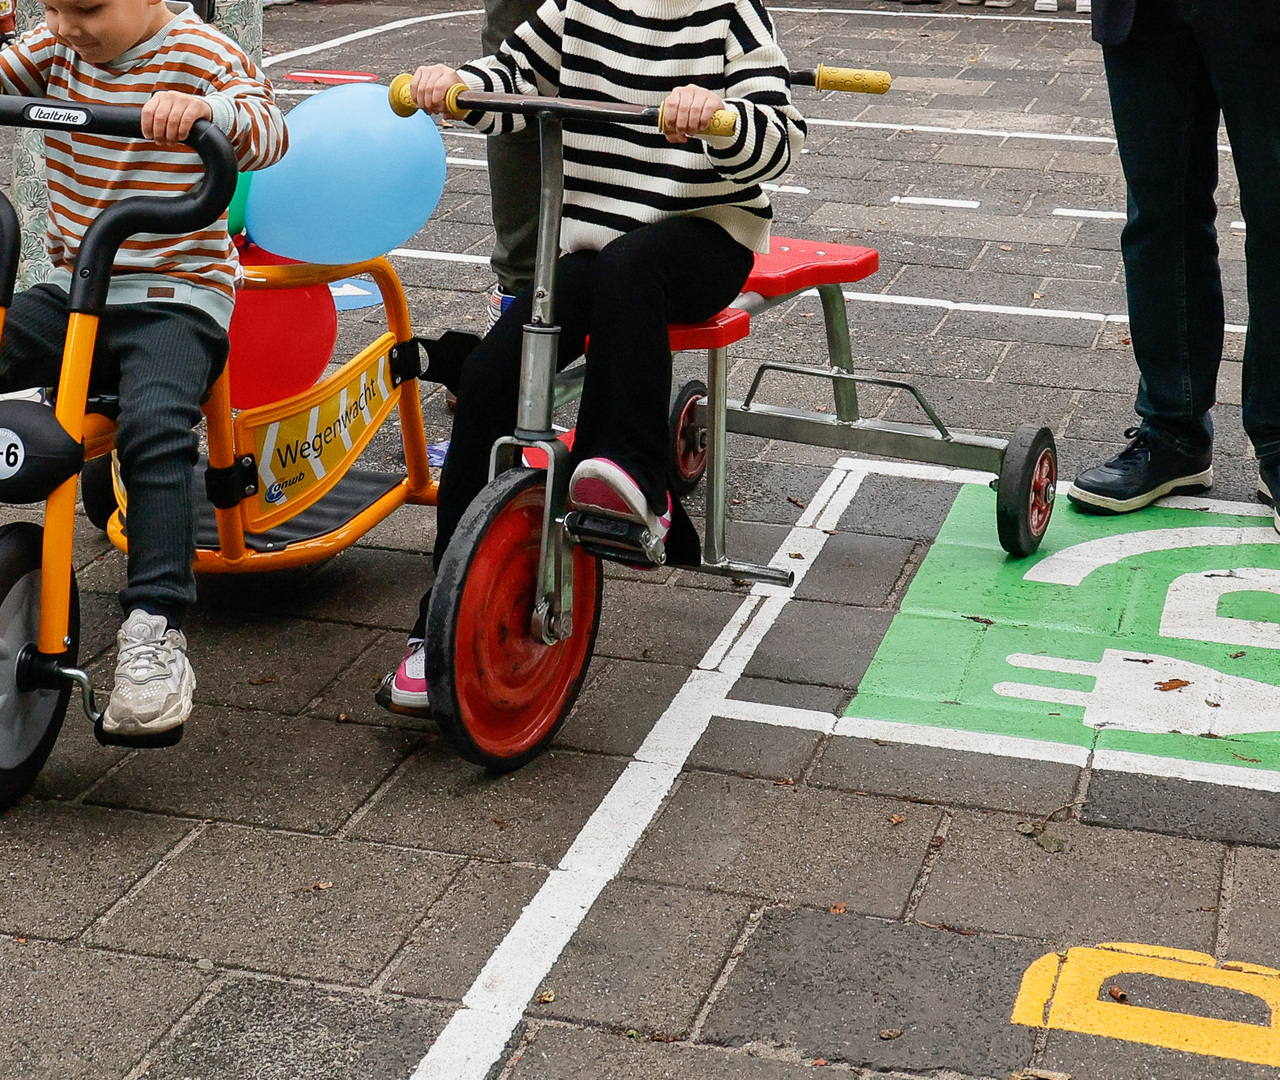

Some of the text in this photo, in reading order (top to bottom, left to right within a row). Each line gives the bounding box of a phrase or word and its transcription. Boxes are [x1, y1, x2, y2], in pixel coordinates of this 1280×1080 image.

[33, 107, 80, 123] Italtrike
[276, 377, 377, 470] Wegenwacht
[272, 471, 306, 494] anwb
